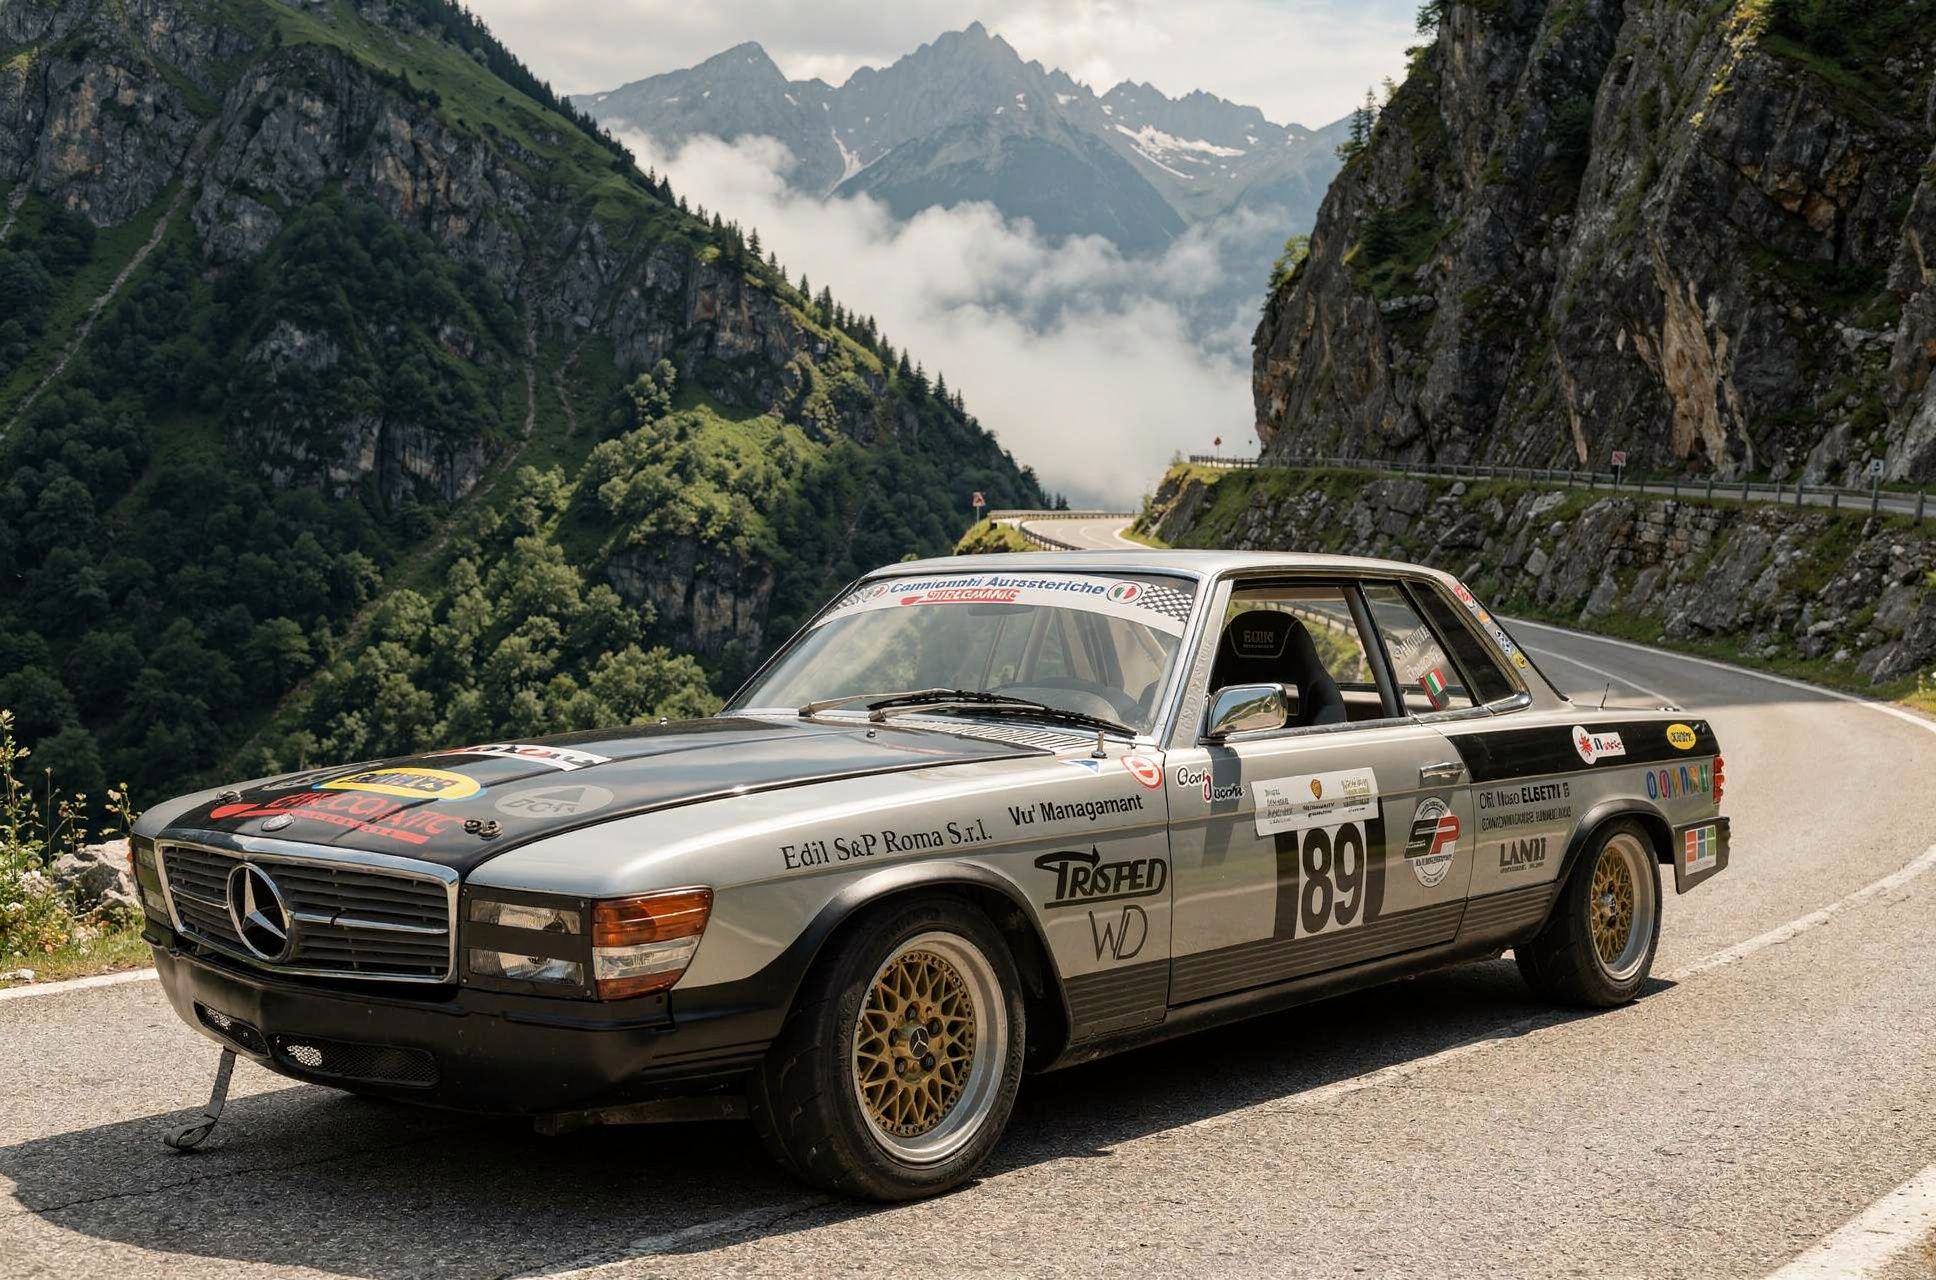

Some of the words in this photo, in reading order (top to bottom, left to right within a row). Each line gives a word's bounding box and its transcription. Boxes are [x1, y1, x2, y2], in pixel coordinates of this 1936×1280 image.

[781, 840, 830, 870] Edil
[834, 833, 877, 861] S&P
[881, 830, 944, 854] Roma
[946, 818, 993, 845] S.r.l.
[1301, 822, 1365, 934] 89
